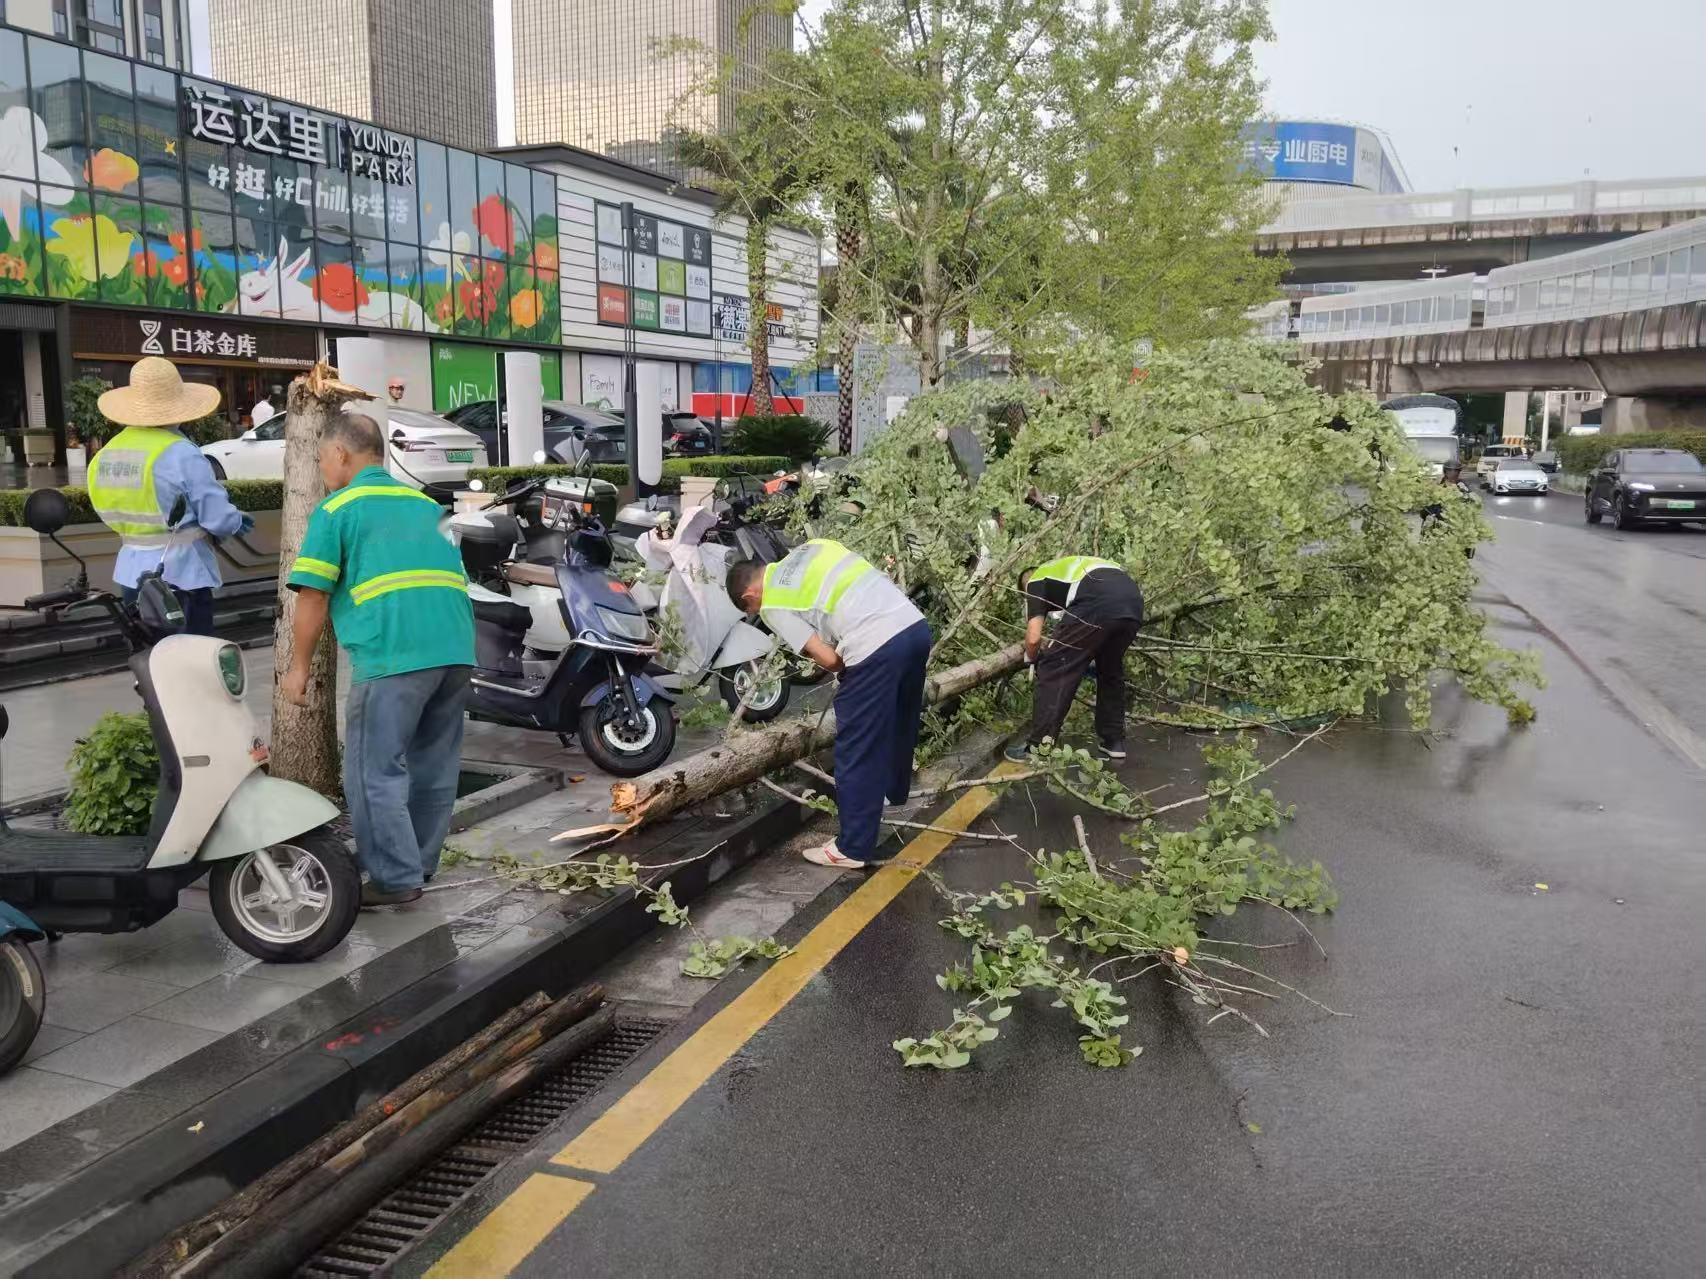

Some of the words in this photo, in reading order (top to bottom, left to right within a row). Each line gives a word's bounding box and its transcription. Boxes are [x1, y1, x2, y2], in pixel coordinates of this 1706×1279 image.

[191, 86, 327, 164] 运达里
[350, 126, 414, 160] YUNDA
[352, 152, 414, 185] PARK
[171, 327, 257, 357] 白茶金库
